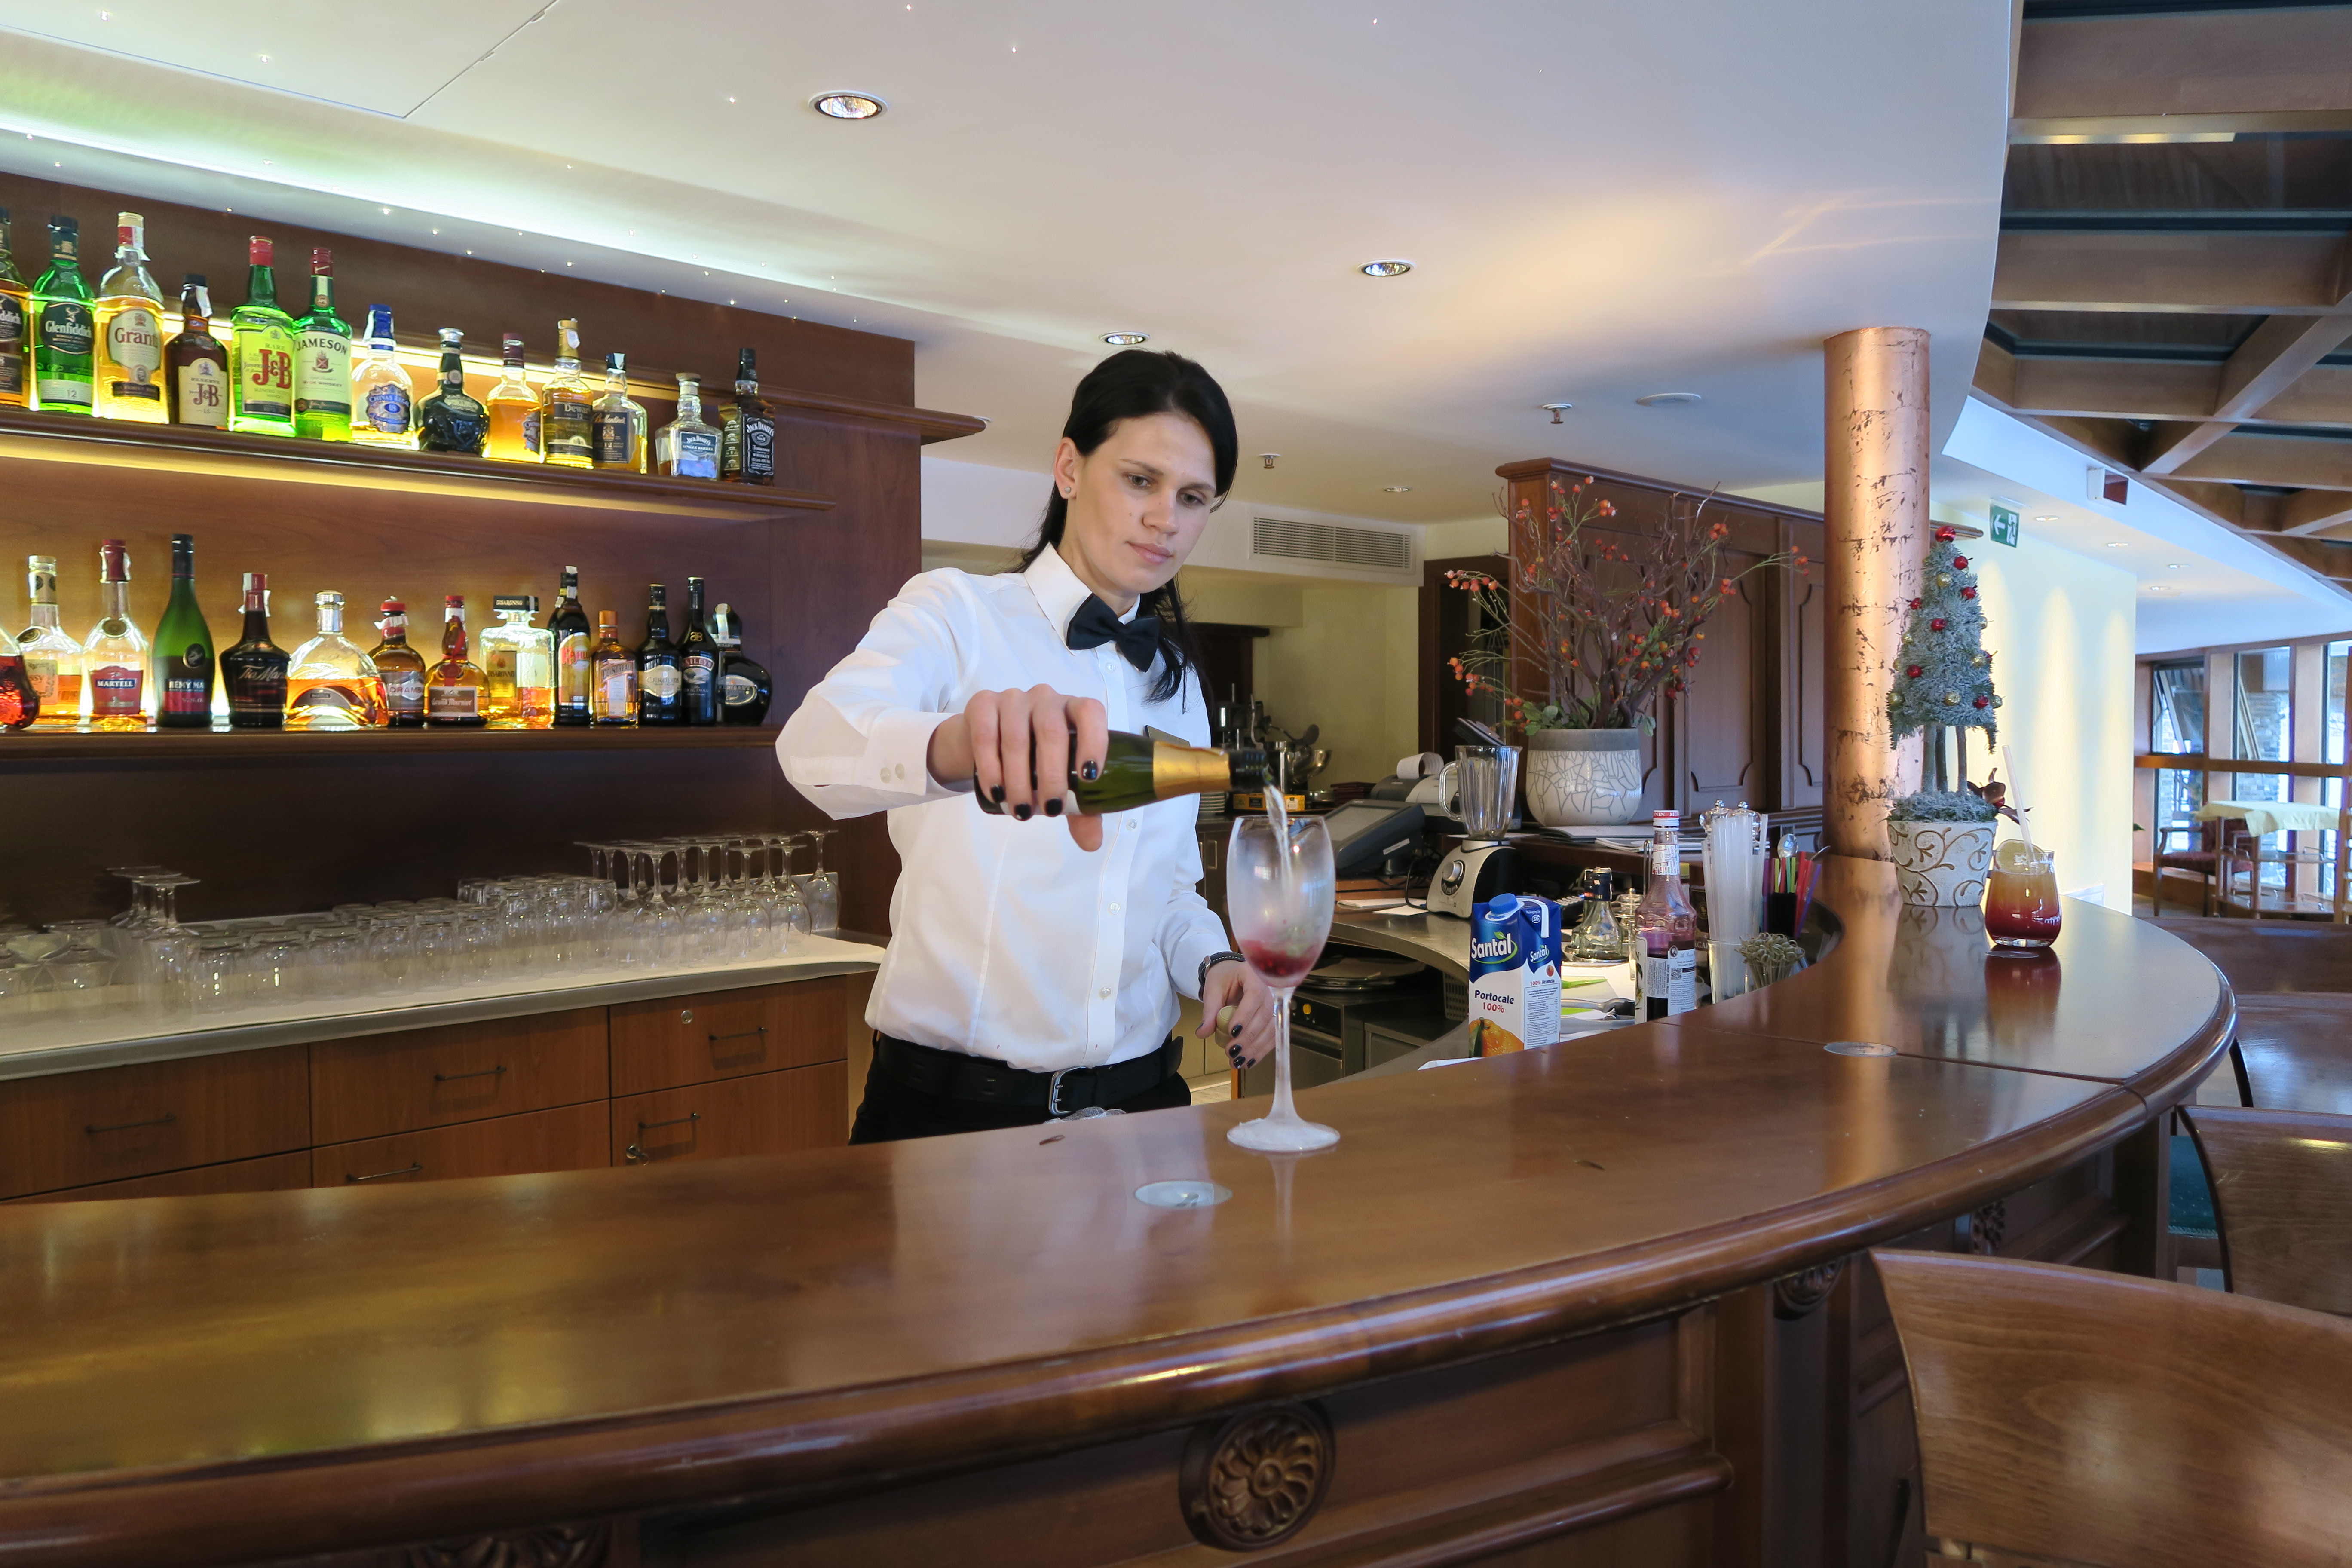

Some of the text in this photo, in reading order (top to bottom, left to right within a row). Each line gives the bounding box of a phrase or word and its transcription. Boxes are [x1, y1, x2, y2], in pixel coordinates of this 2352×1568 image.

[297, 338, 347, 355] JAMESON
[251, 349, 291, 389] J&B
[193, 383, 219, 407] J&B
[746, 423, 758, 433] JACK
[603, 664, 633, 679] COINTREAU
[1471, 933, 1511, 959] Santal
[1530, 945, 1547, 962] Santal
[1475, 990, 1514, 1004] Portocale
[1483, 1002, 1504, 1013] 100%
